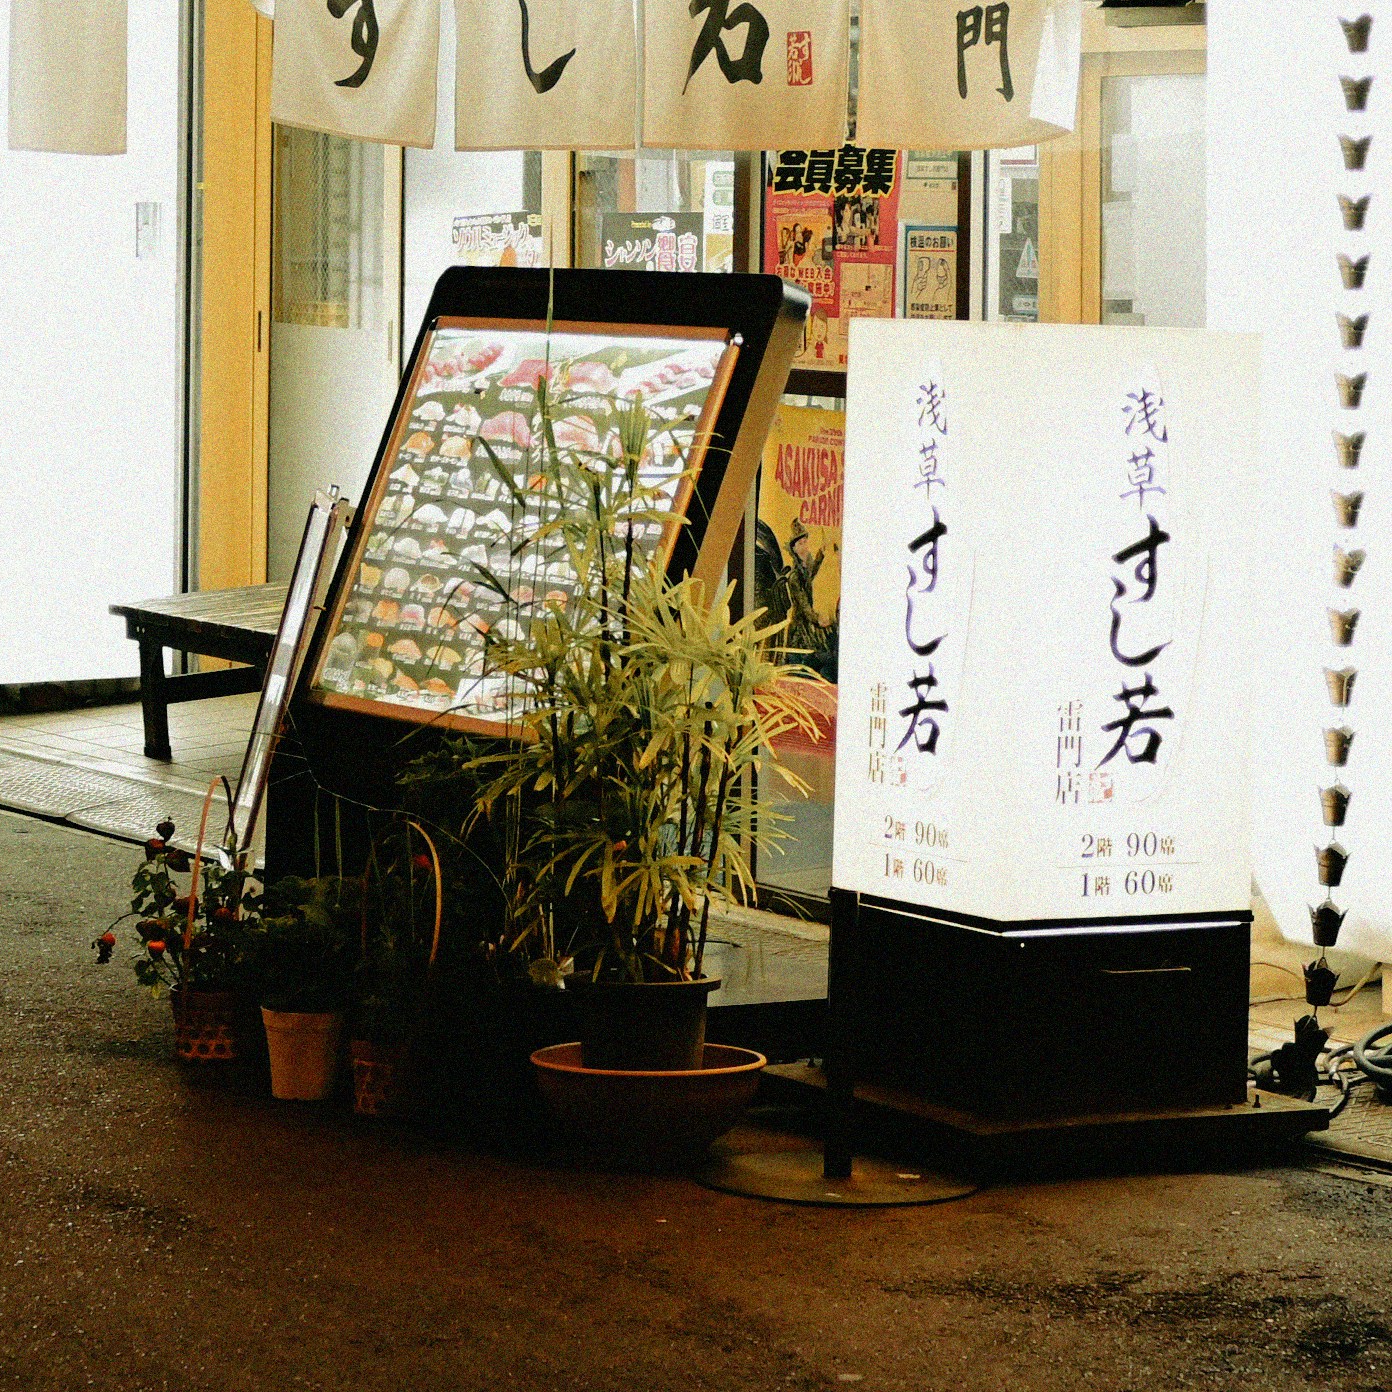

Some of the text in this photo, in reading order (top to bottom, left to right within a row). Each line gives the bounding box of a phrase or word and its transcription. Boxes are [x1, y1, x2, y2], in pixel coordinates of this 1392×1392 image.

[774, 443, 837, 498] ASAKUSA
[867, 682, 889, 785] 雷門店
[1055, 698, 1085, 805] 雷門店
